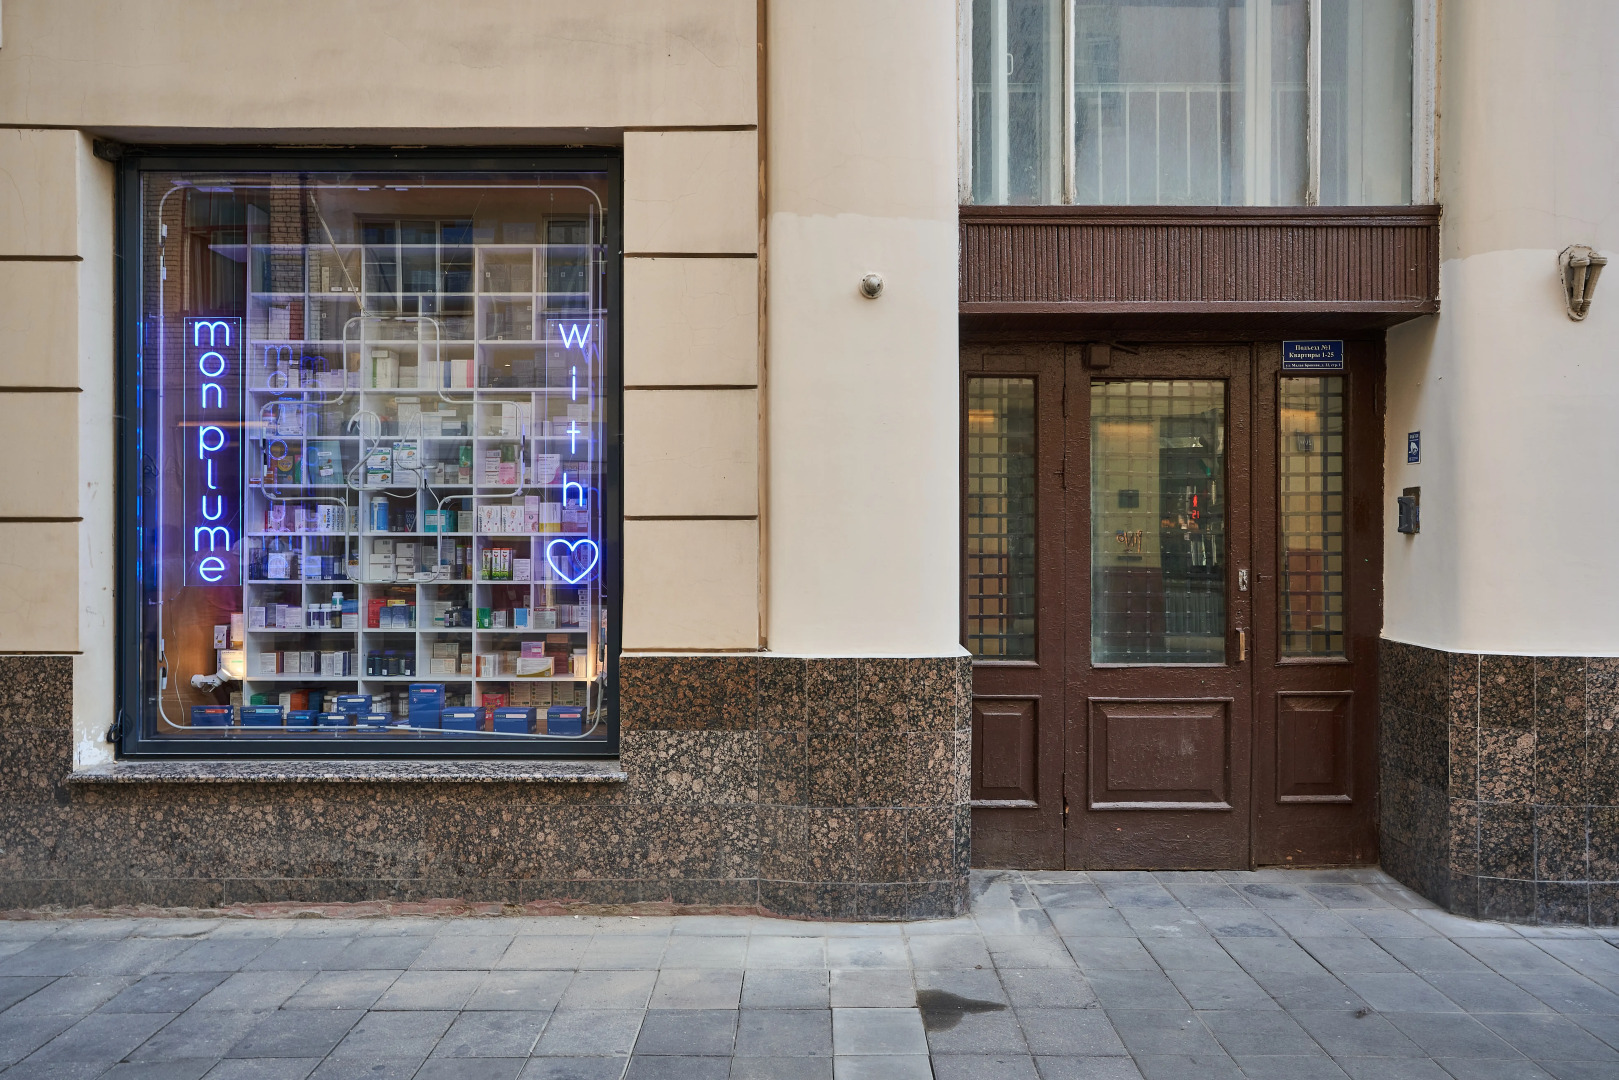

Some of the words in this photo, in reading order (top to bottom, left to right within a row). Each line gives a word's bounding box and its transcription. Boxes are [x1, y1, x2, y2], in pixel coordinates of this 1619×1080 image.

[193, 320, 230, 409] mon
[558, 323, 591, 508] with
[193, 424, 230, 583] plume
